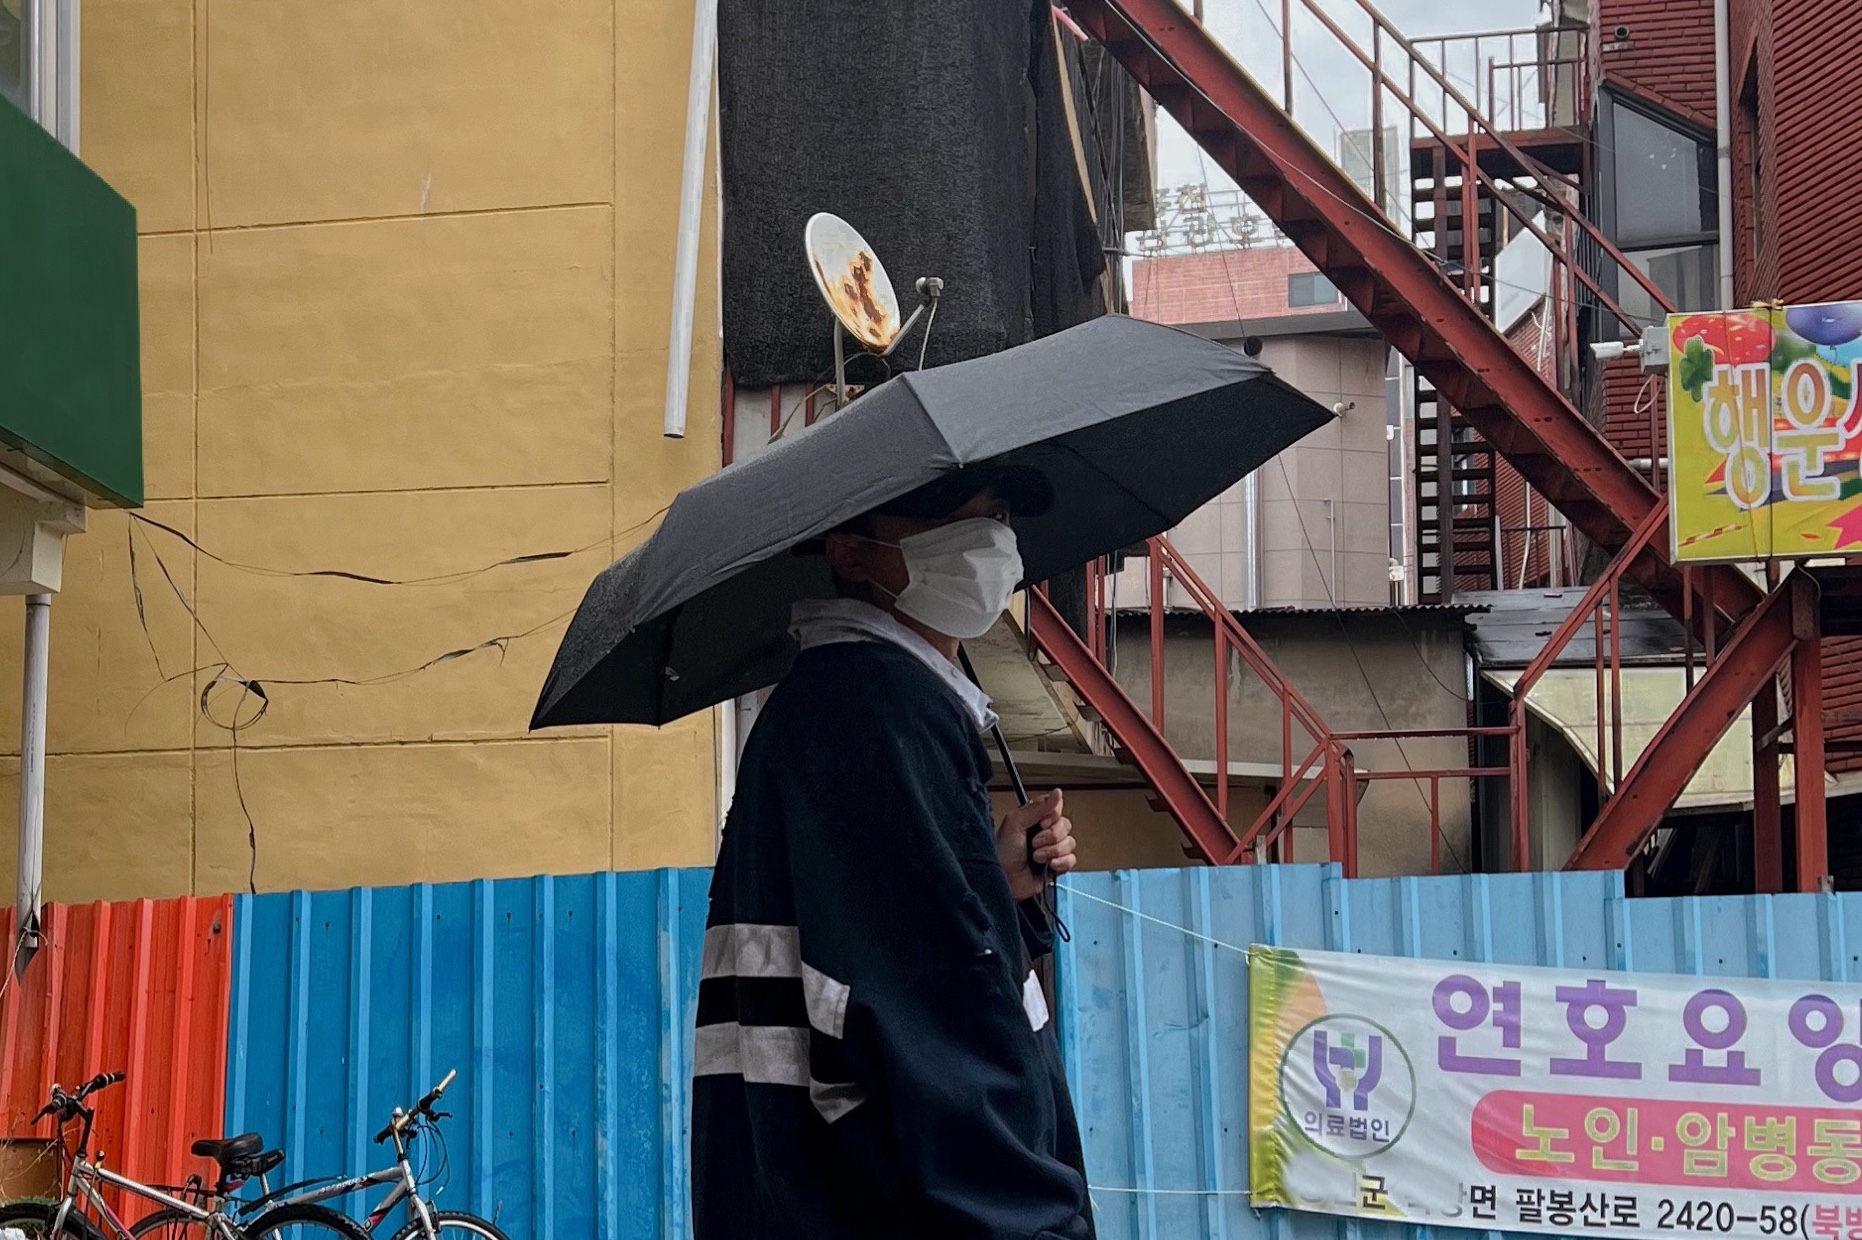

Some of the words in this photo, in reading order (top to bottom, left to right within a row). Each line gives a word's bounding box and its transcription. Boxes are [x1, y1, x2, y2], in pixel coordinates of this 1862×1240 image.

[1703, 359, 1862, 509] 행운
[1304, 1111, 1390, 1143] 의료법인
[1515, 1187, 1641, 1229] 팔봉산로
